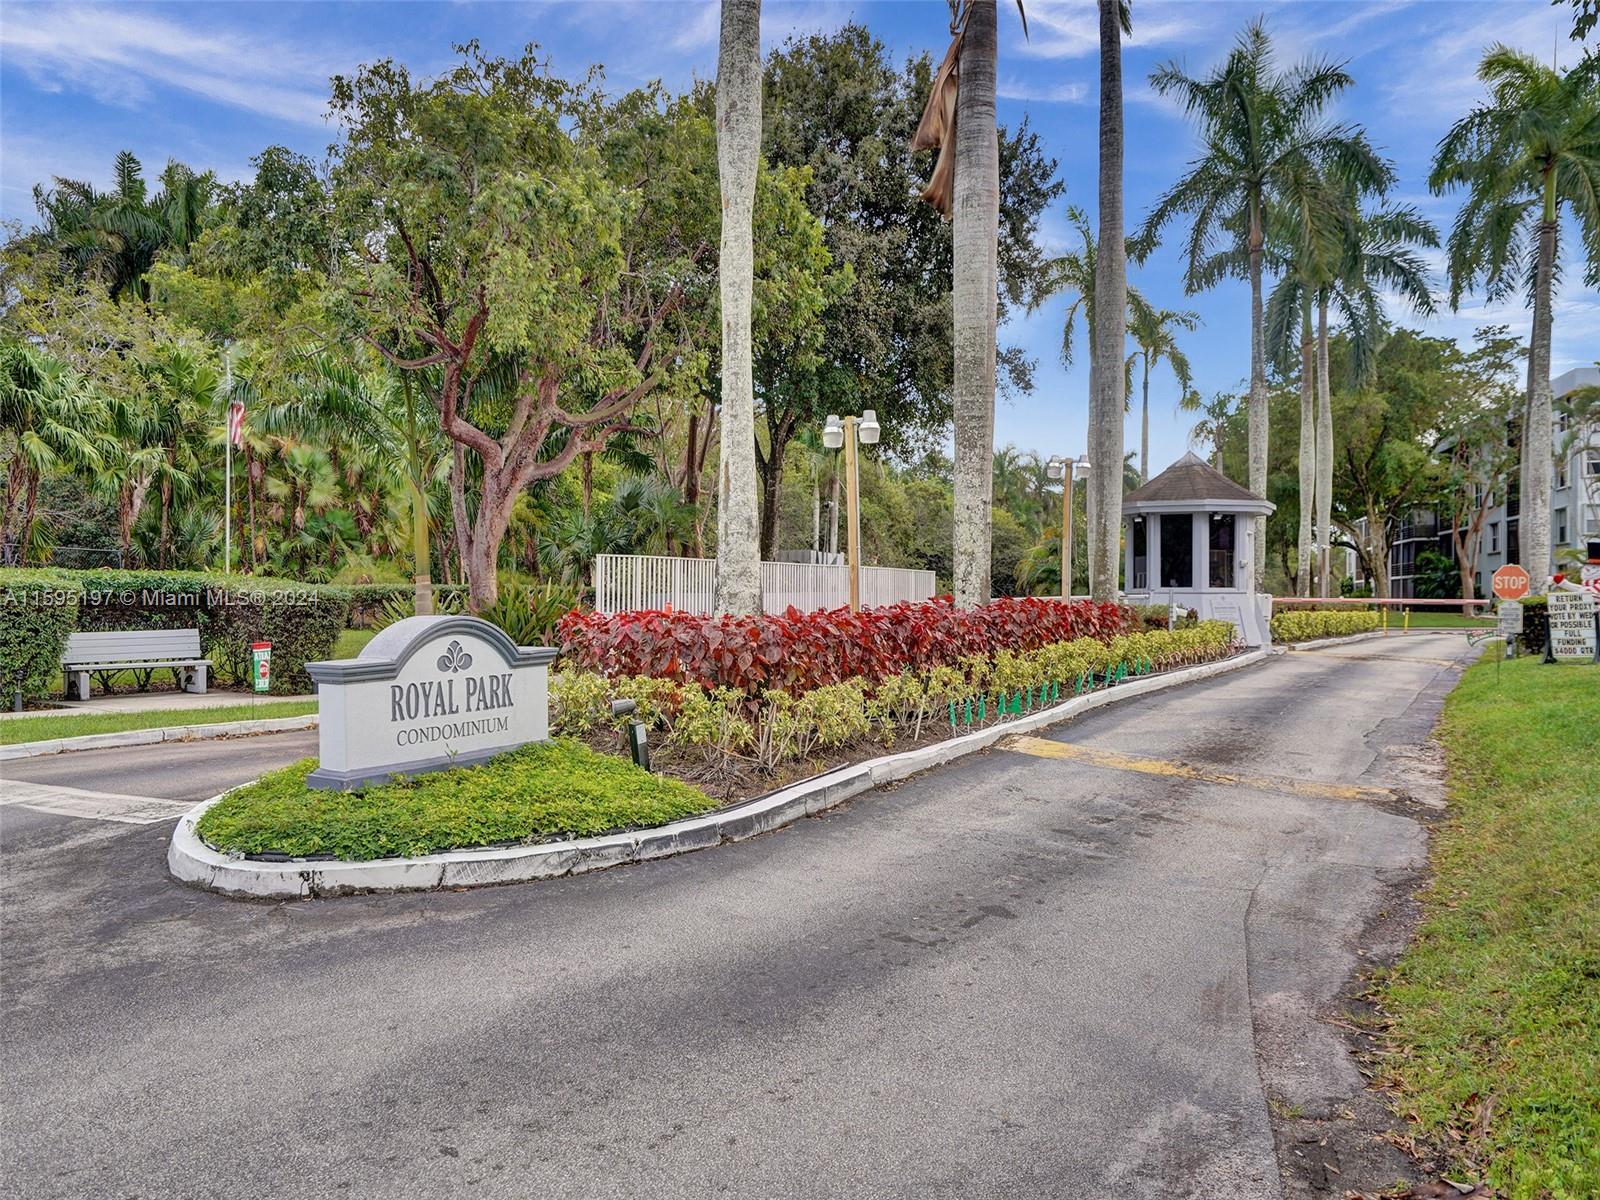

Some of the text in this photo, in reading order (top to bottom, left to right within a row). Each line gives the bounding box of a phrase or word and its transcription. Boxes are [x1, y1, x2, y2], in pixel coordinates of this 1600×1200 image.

[1495, 576, 1527, 589] STOP
[1556, 594, 1583, 602] RETURN
[1570, 602, 1592, 610] PROXY
[1560, 620, 1592, 628] POSSIBLE
[390, 673, 514, 722] ROYAL PARK
[396, 716, 509, 747] CONDOMINIUM
